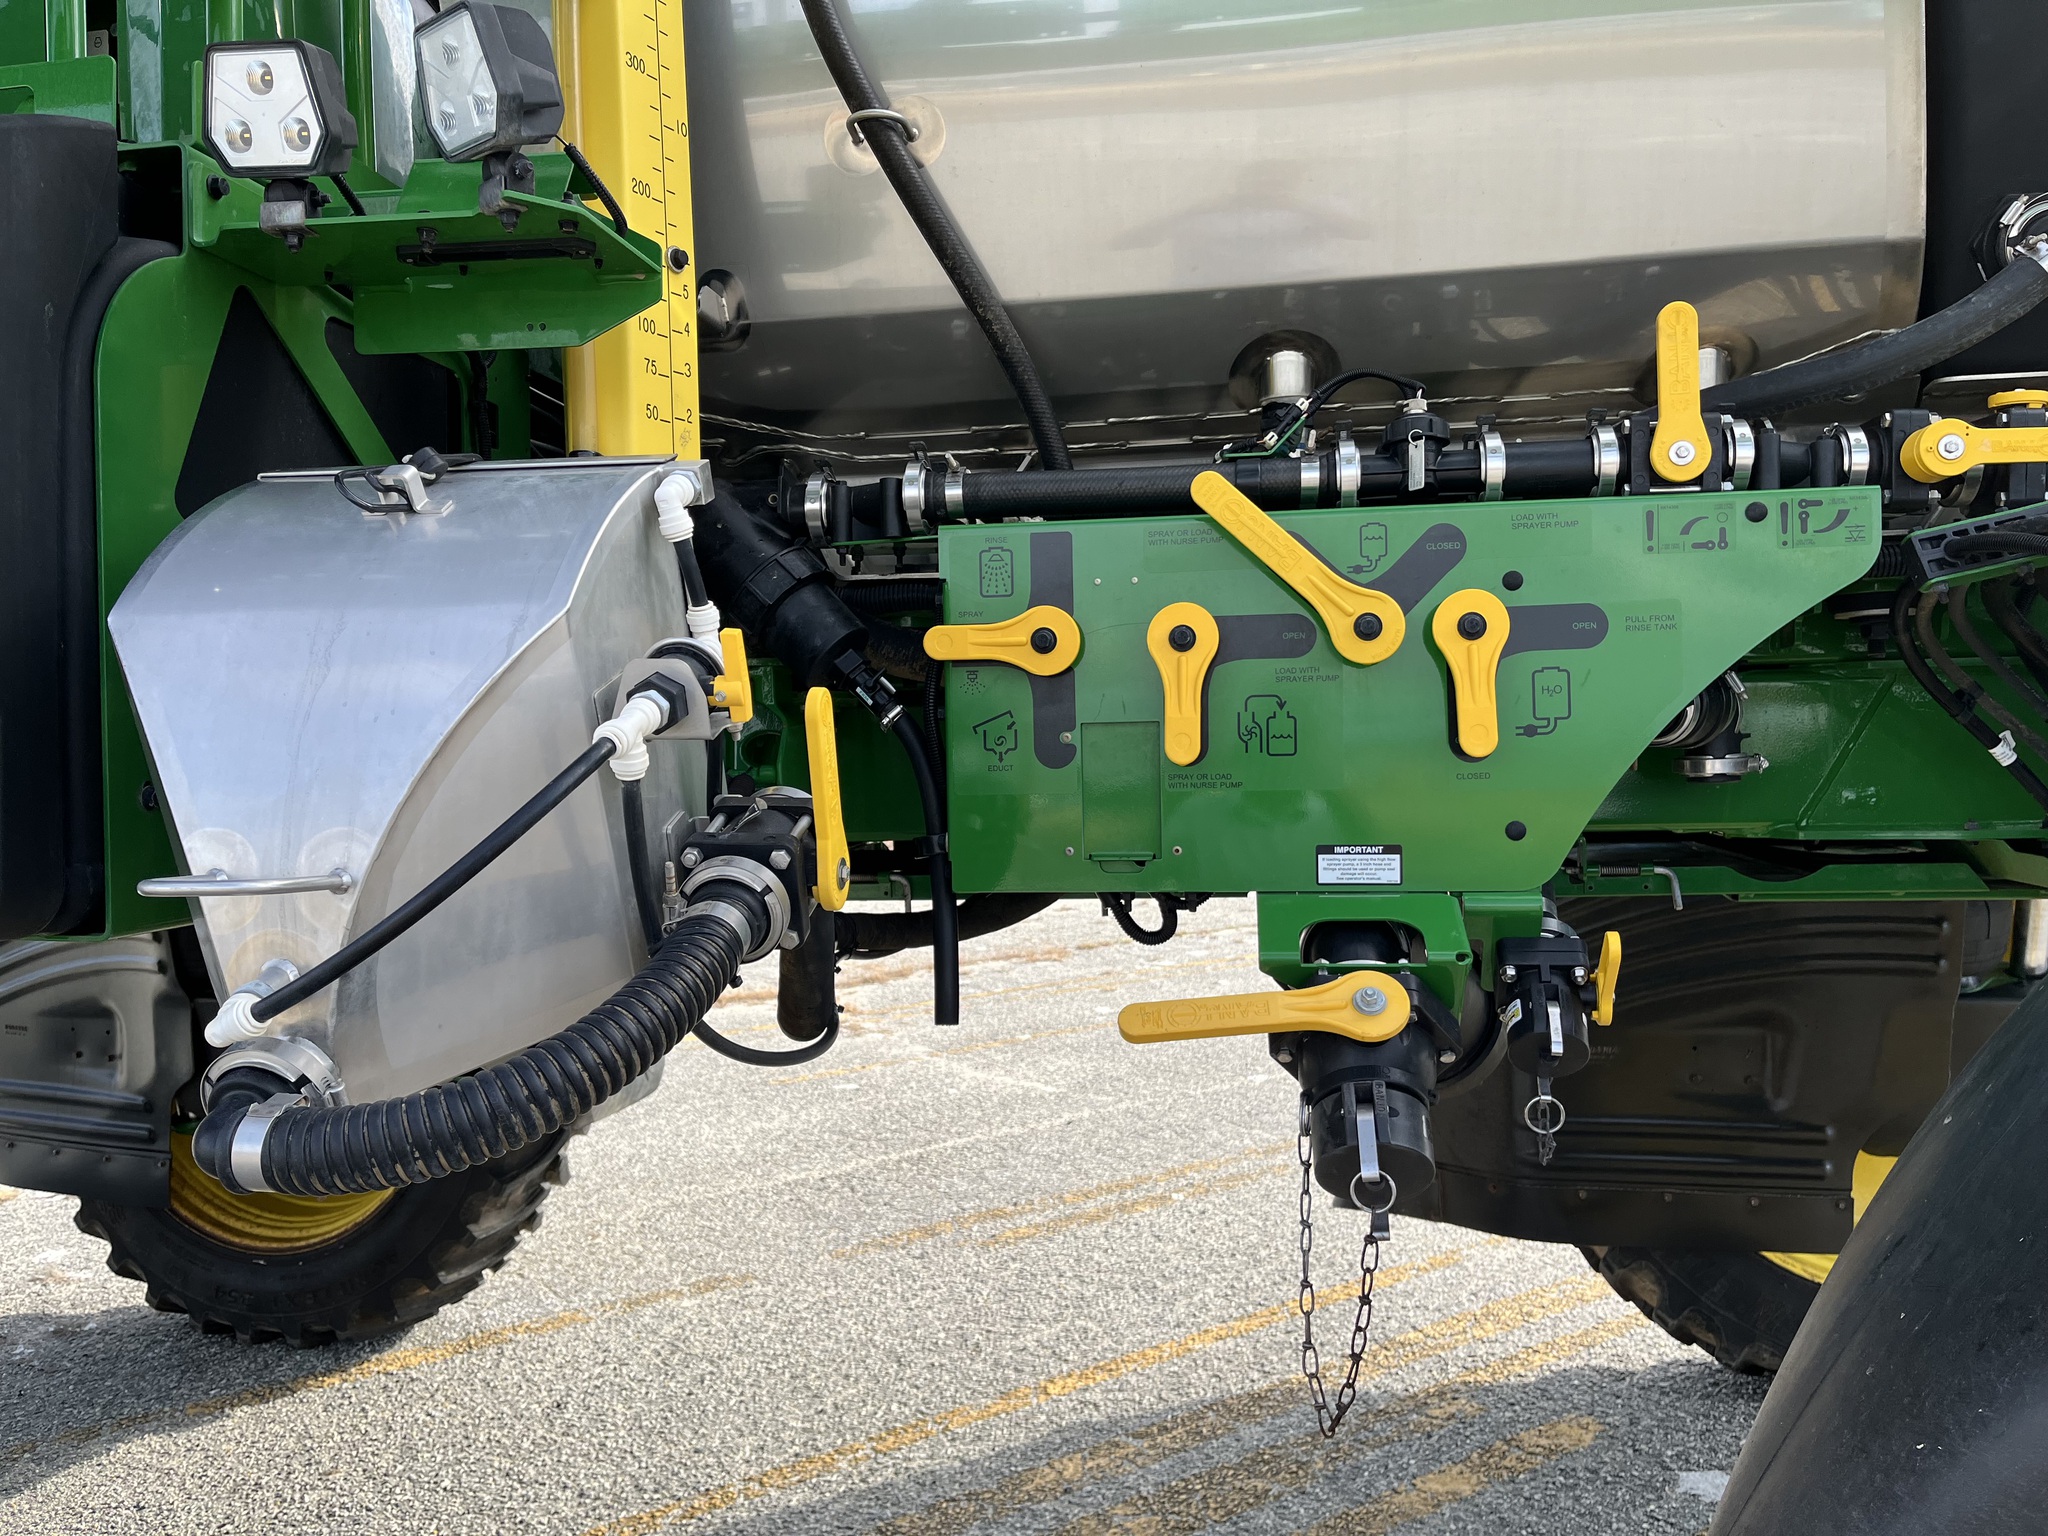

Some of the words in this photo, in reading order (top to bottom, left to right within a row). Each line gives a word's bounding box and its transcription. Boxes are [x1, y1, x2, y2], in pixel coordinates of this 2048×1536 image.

[626, 52, 645, 74] 300
[676, 120, 687, 137] 10
[632, 178, 651, 198] 200
[682, 285, 689, 299] 5
[638, 316, 656, 335] 100
[684, 322, 690, 337] 4
[644, 358, 657, 375] 75
[685, 363, 691, 377] 3
[646, 404, 658, 421] 50
[687, 409, 692, 423] 2
[1511, 514, 1534, 522] LOAD
[1537, 512, 1559, 521] WITH
[1511, 521, 1551, 530] SPRAYER
[1554, 520, 1579, 528] PUMP
[1148, 530, 1175, 538] SPRAY
[1175, 529, 1189, 538] OR
[1190, 528, 1213, 537] LOAD
[984, 536, 1008, 544] RINSE
[1148, 538, 1169, 546] WITH
[1170, 537, 1200, 546] NURSE
[1201, 536, 1225, 544] PUMP
[1426, 541, 1461, 551] CLOSED
[958, 610, 983, 618] SPRAY
[1625, 615, 1645, 623] PULL
[1648, 614, 1675, 623] FROM
[1572, 622, 1597, 630] OPEN
[1625, 623, 1652, 633] RINSE
[1653, 622, 1679, 632] TANK
[1282, 631, 1305, 639] OPEN
[1275, 667, 1299, 675] LOAD
[1299, 666, 1321, 675] WITH
[1275, 674, 1314, 683] SPRAYER
[1314, 674, 1340, 682] PUMP
[987, 764, 1013, 772] EDUCT
[1196, 773, 1206, 781] OR
[1210, 772, 1233, 781] LOAD
[1456, 771, 1491, 780] CLOSED
[1168, 781, 1188, 789] WITH
[1190, 781, 1218, 789] NURSE
[1220, 781, 1243, 789] PUMP
